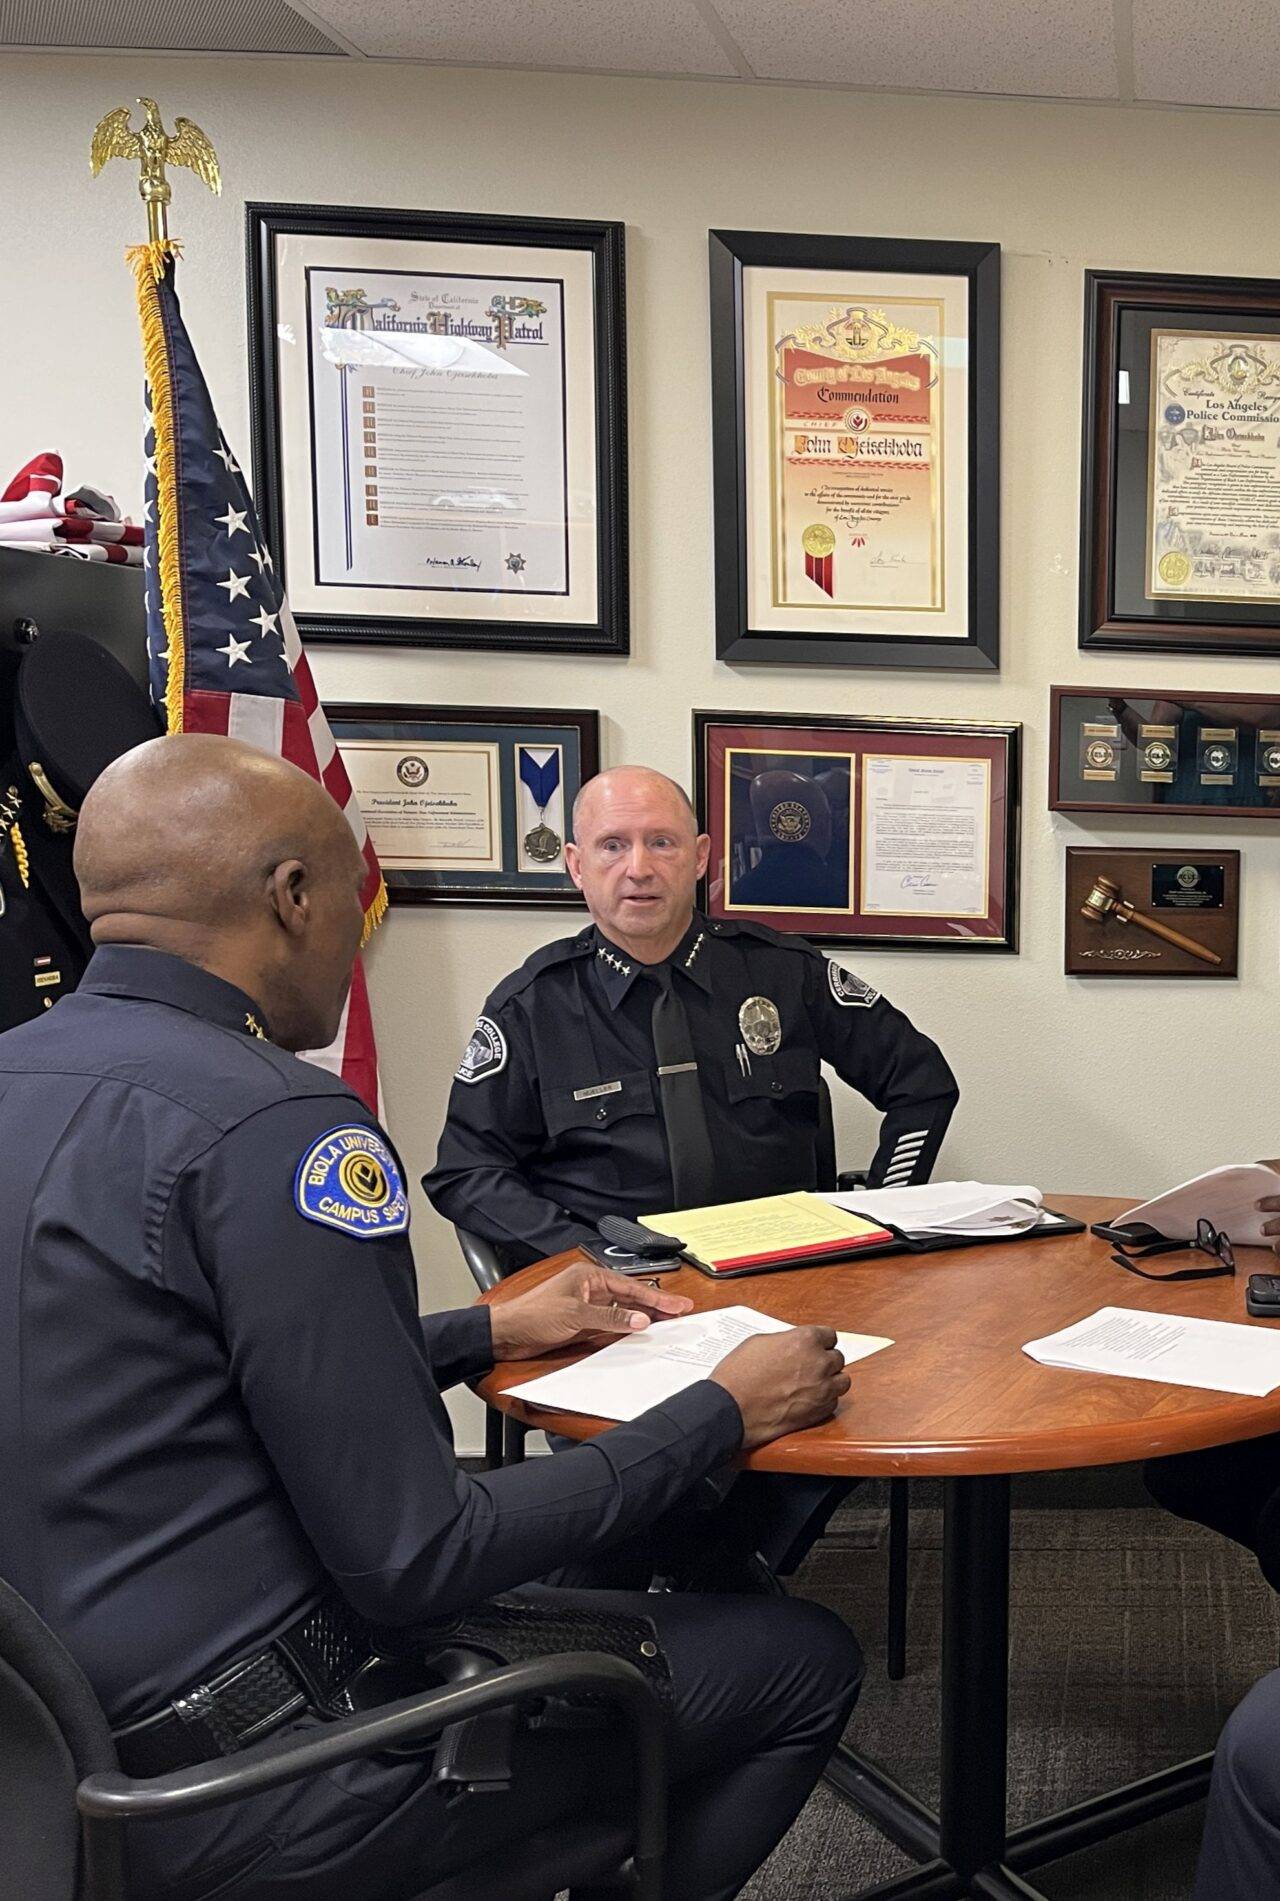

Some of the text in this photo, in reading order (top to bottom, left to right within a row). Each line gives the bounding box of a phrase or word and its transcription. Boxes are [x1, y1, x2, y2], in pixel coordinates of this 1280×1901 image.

[441, 293, 479, 305] California
[427, 311, 492, 342] Highway
[488, 311, 543, 350] Patrol
[817, 386, 899, 404] Commendation
[1186, 410, 1218, 420] Police
[1206, 399, 1268, 413] Los Angeles
[792, 435, 831, 456] John
[483, 1023, 502, 1060] COLLEGE
[308, 1145, 343, 1187] BIOLA
[319, 1196, 380, 1224] CAMPUS
